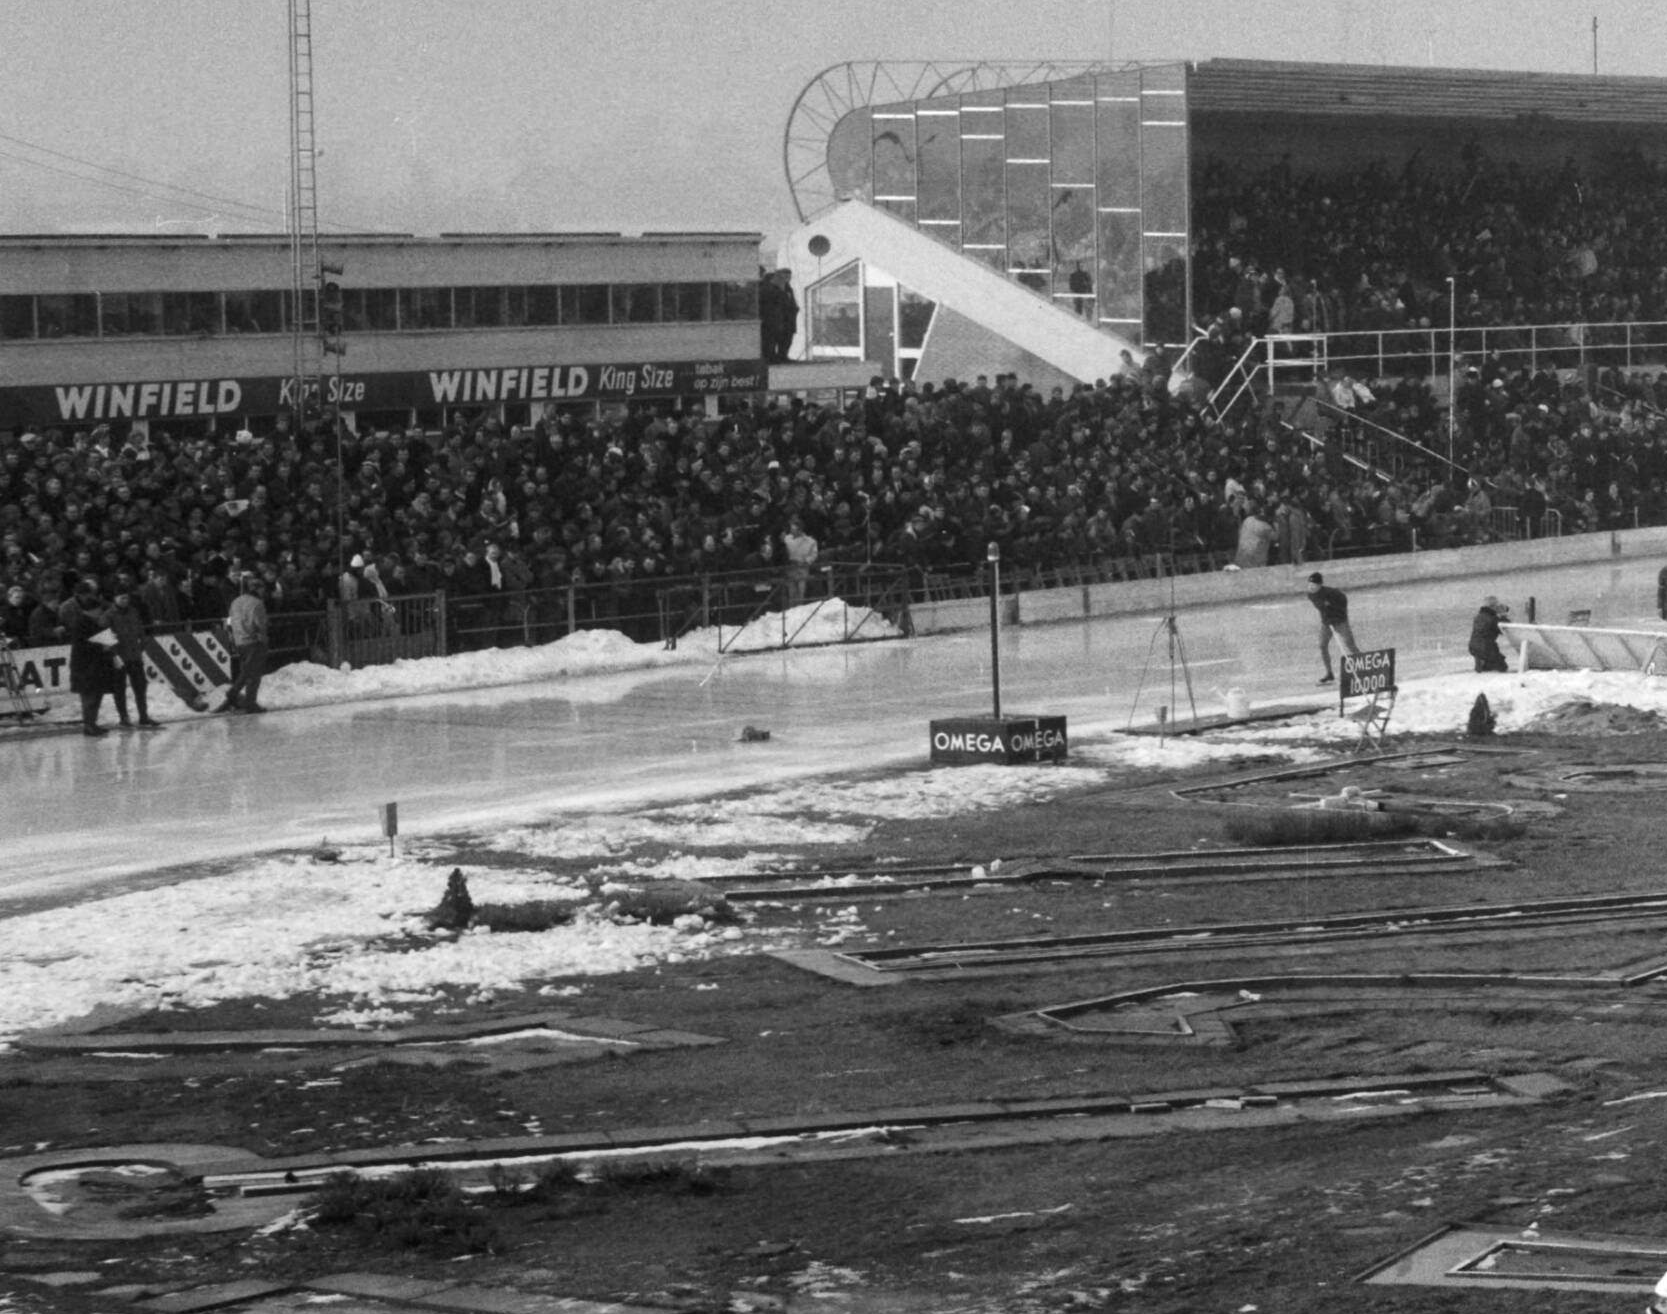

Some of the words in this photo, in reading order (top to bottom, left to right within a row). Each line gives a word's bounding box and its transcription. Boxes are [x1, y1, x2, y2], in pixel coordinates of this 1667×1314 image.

[694, 363, 725, 375] tabak
[429, 367, 588, 403] WINFIELD
[600, 365, 635, 395] King
[641, 364, 674, 389] Size
[693, 377, 708, 390] op
[709, 375, 729, 391] zijn
[56, 380, 242, 420] WINFIELD
[327, 376, 365, 402] Size
[1344, 652, 1391, 673] OMEGA
[934, 732, 1006, 753] OMEGA
[1010, 729, 1065, 752] OMEGA
